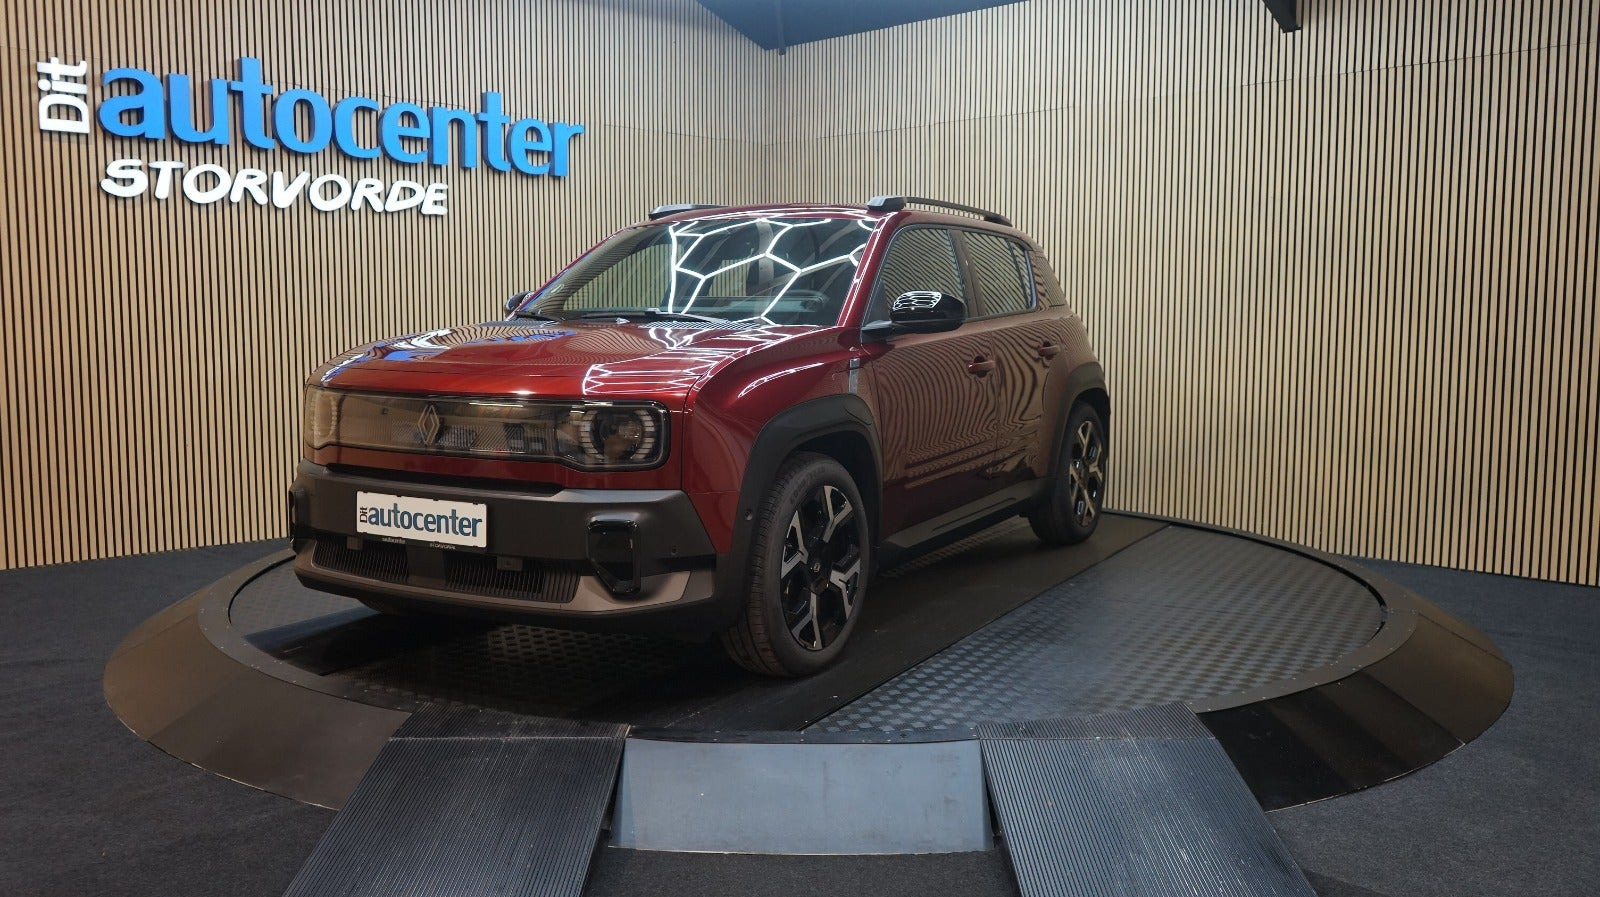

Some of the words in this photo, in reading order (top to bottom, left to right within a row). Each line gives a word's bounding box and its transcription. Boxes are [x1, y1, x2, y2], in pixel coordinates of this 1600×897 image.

[37, 57, 89, 134] Dit
[99, 57, 584, 177] autocenter
[100, 158, 449, 216] STORVORDE
[368, 503, 482, 537] autocenter
